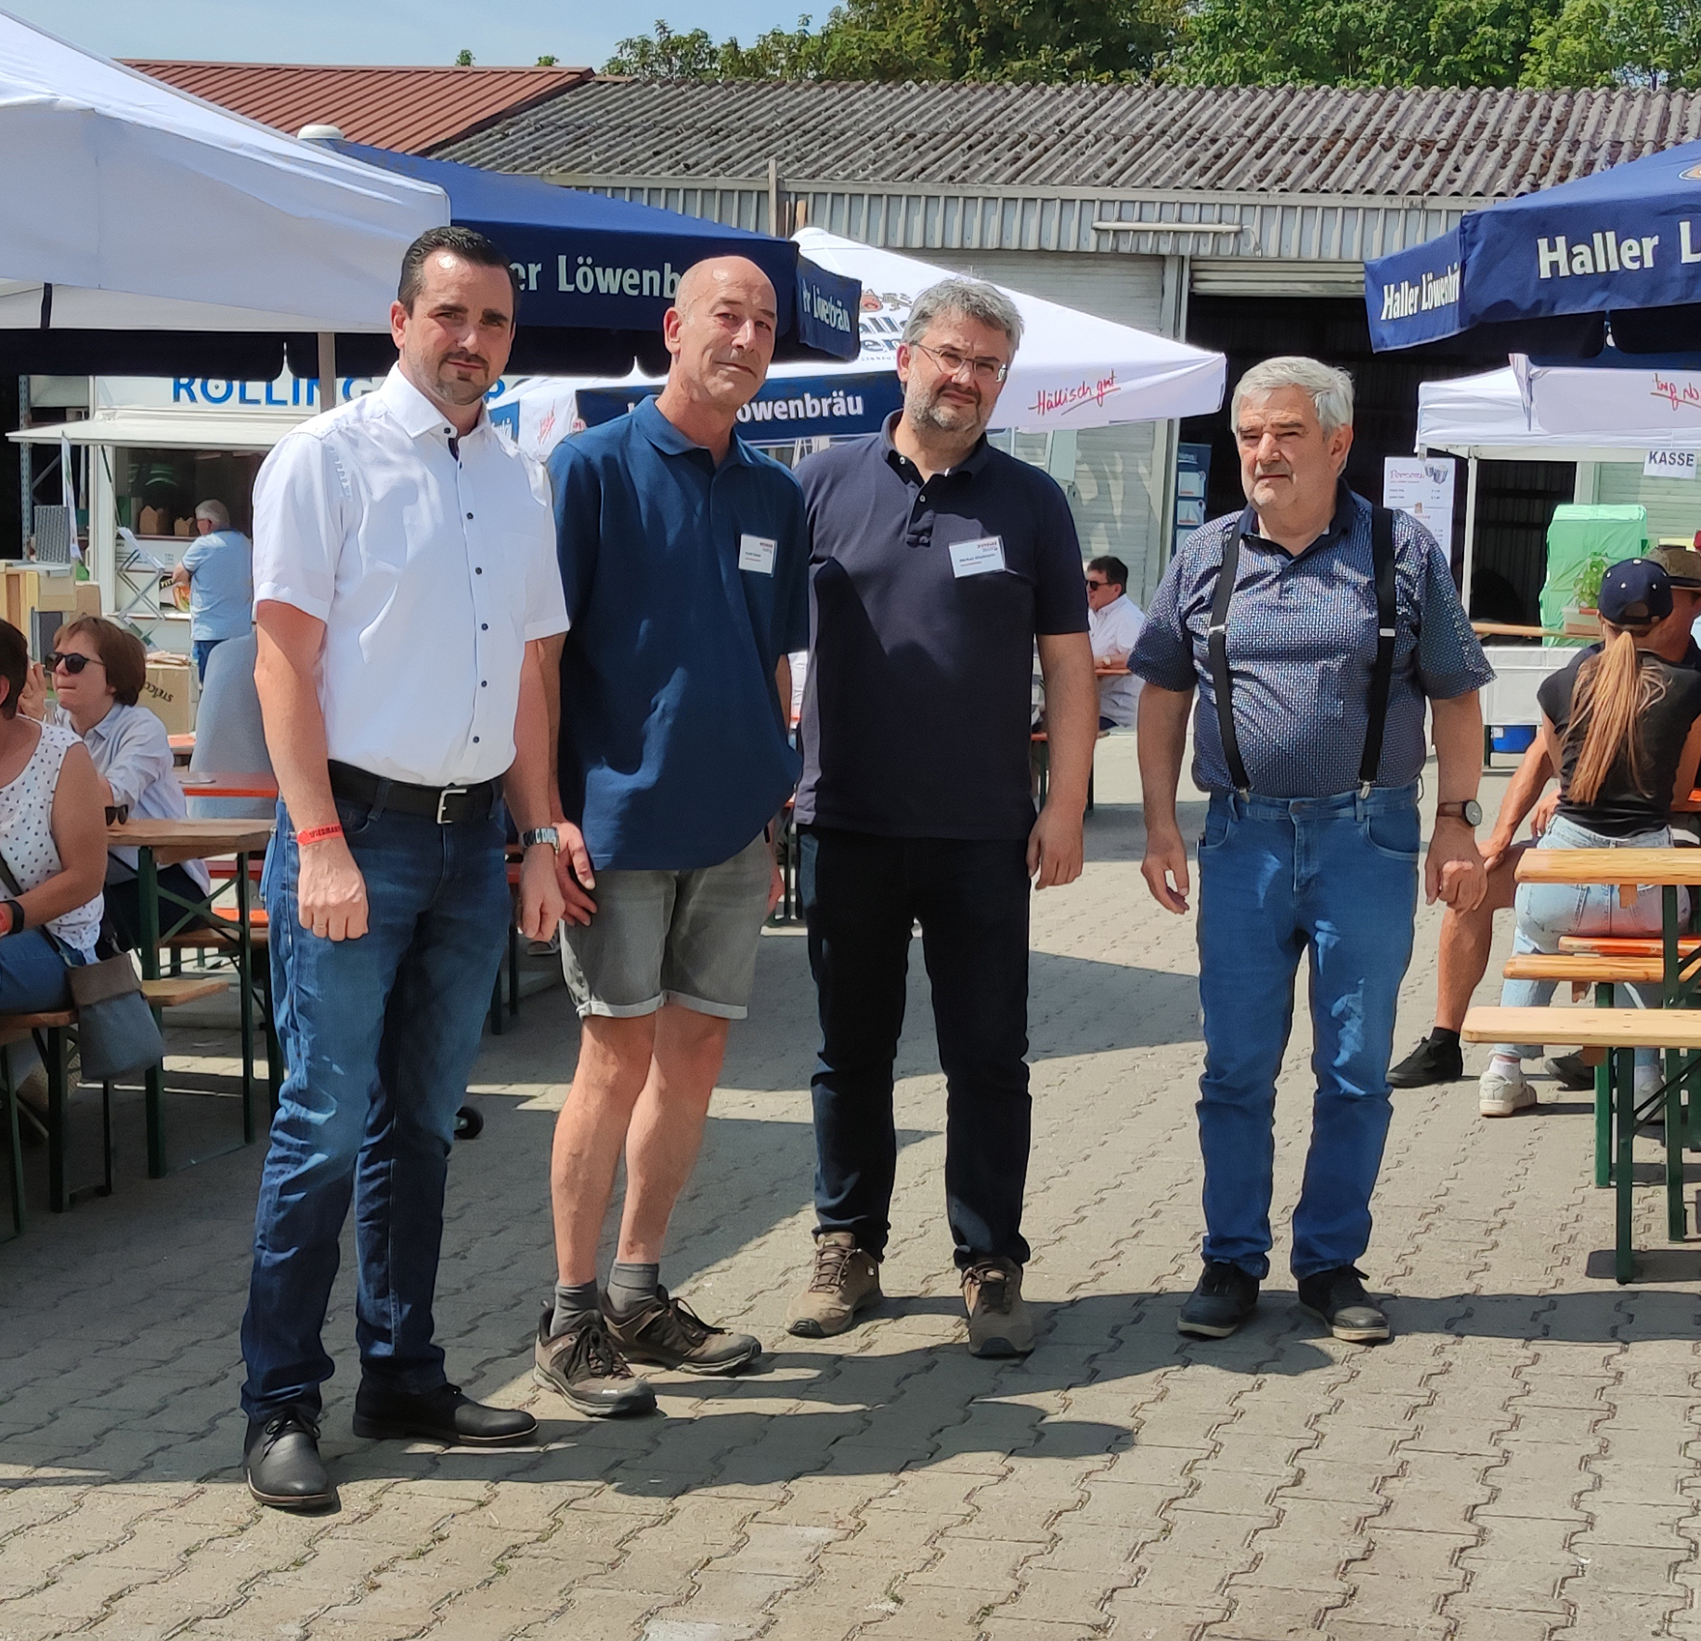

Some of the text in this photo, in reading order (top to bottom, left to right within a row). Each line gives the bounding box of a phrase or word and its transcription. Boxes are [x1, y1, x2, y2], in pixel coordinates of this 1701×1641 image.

[1537, 230, 1659, 279] Haller
[1380, 280, 1419, 320] Haller
[1028, 380, 1092, 416] Hällisch
[1648, 450, 1695, 467] KASSE
